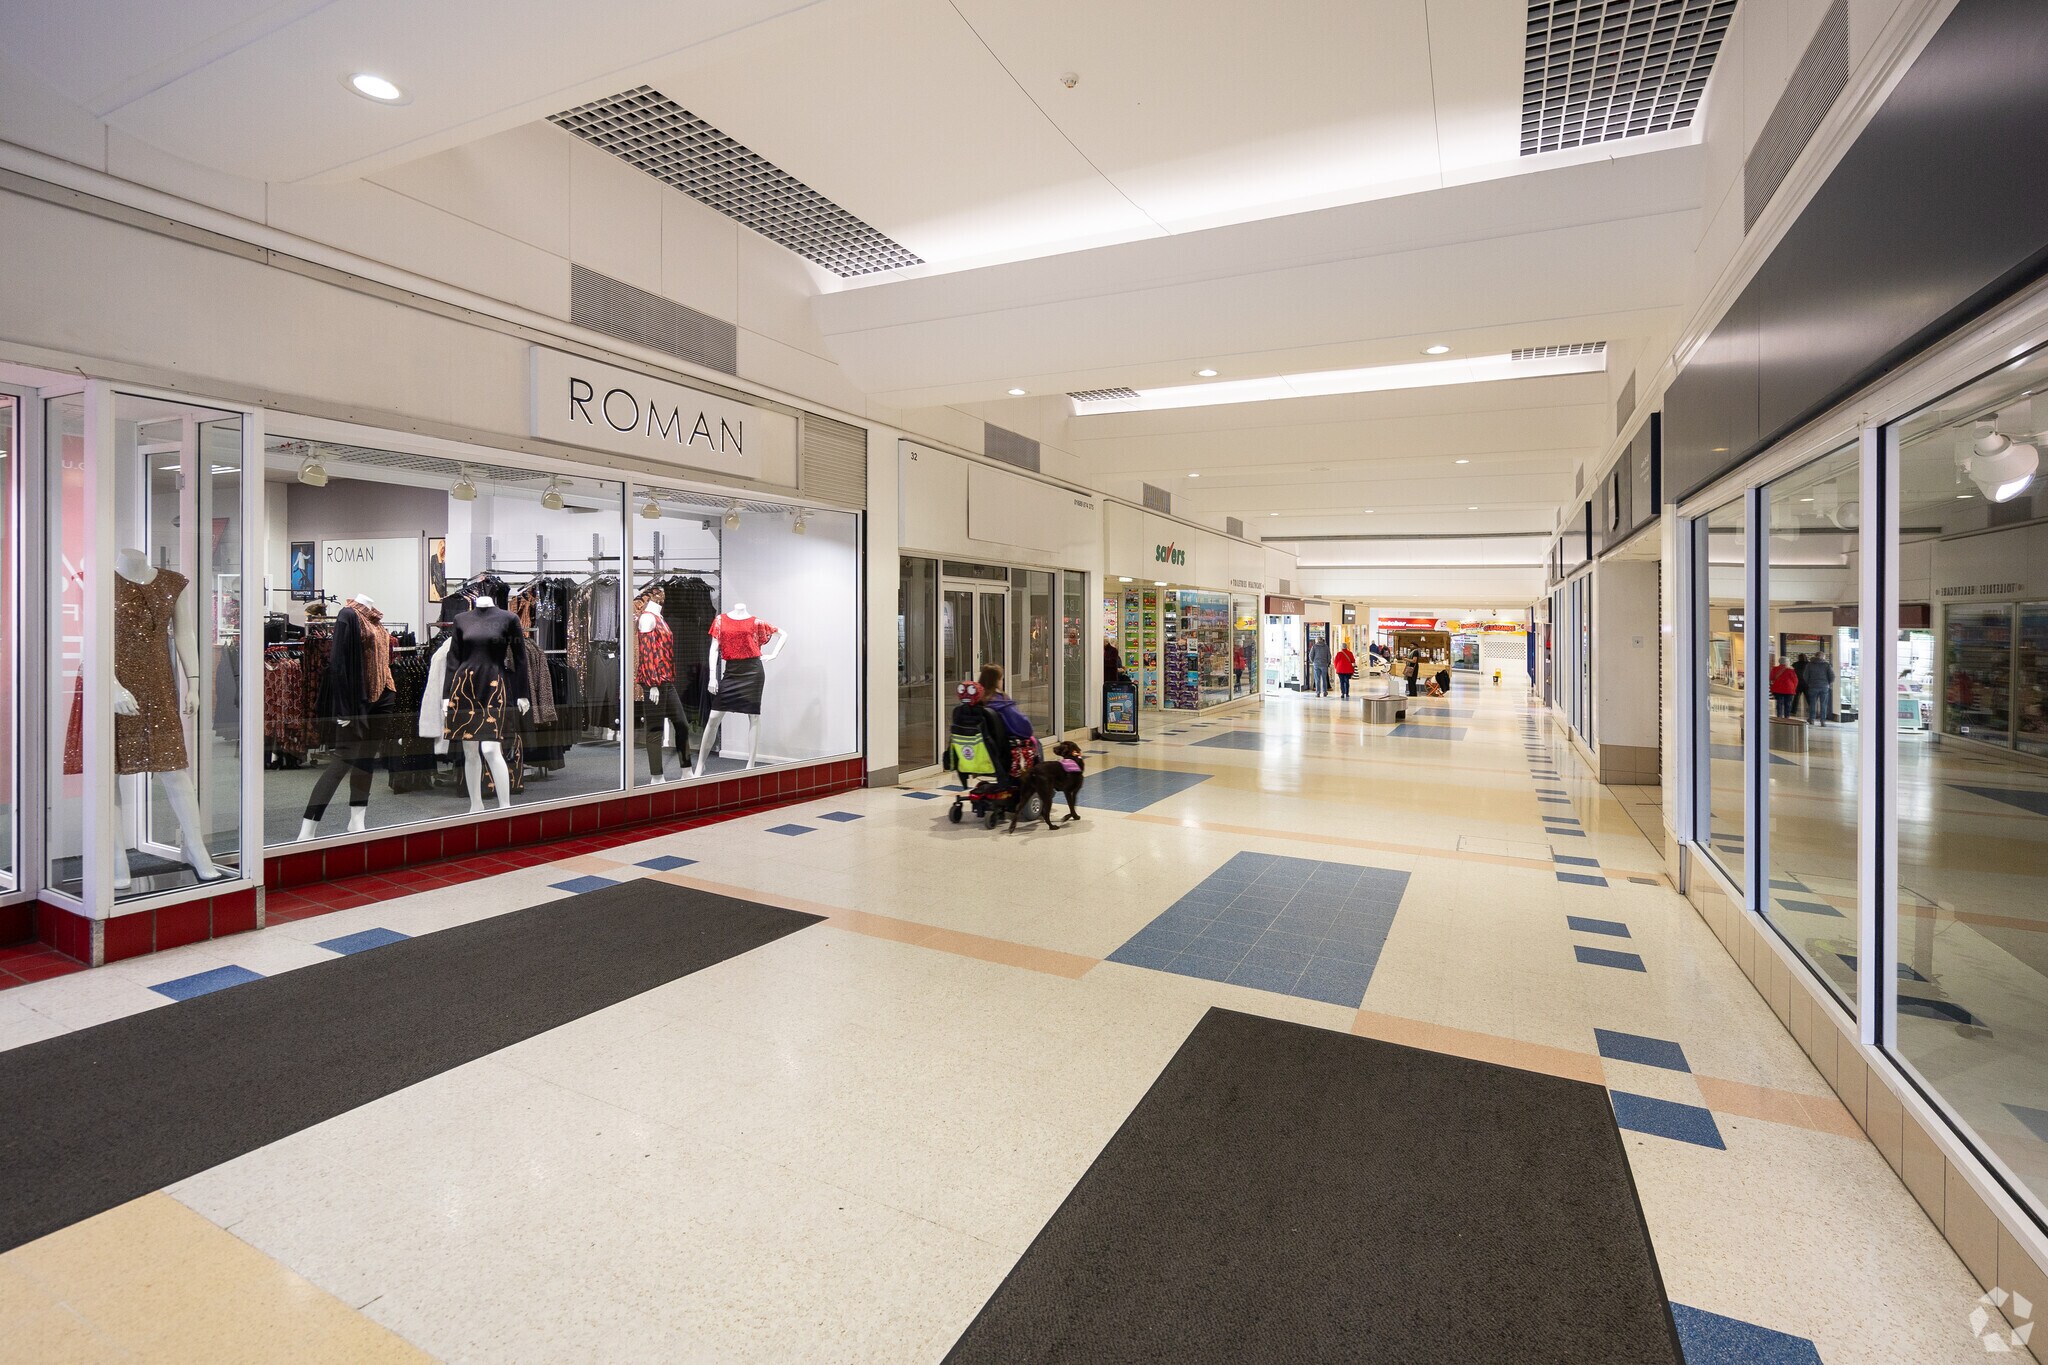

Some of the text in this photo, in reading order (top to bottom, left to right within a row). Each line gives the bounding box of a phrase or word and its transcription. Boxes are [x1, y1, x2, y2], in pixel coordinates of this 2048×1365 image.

[569, 377, 743, 457] ROMAN
[911, 451, 918, 461] 32
[327, 546, 374, 563] ROMAN
[1156, 541, 1185, 566] savers
